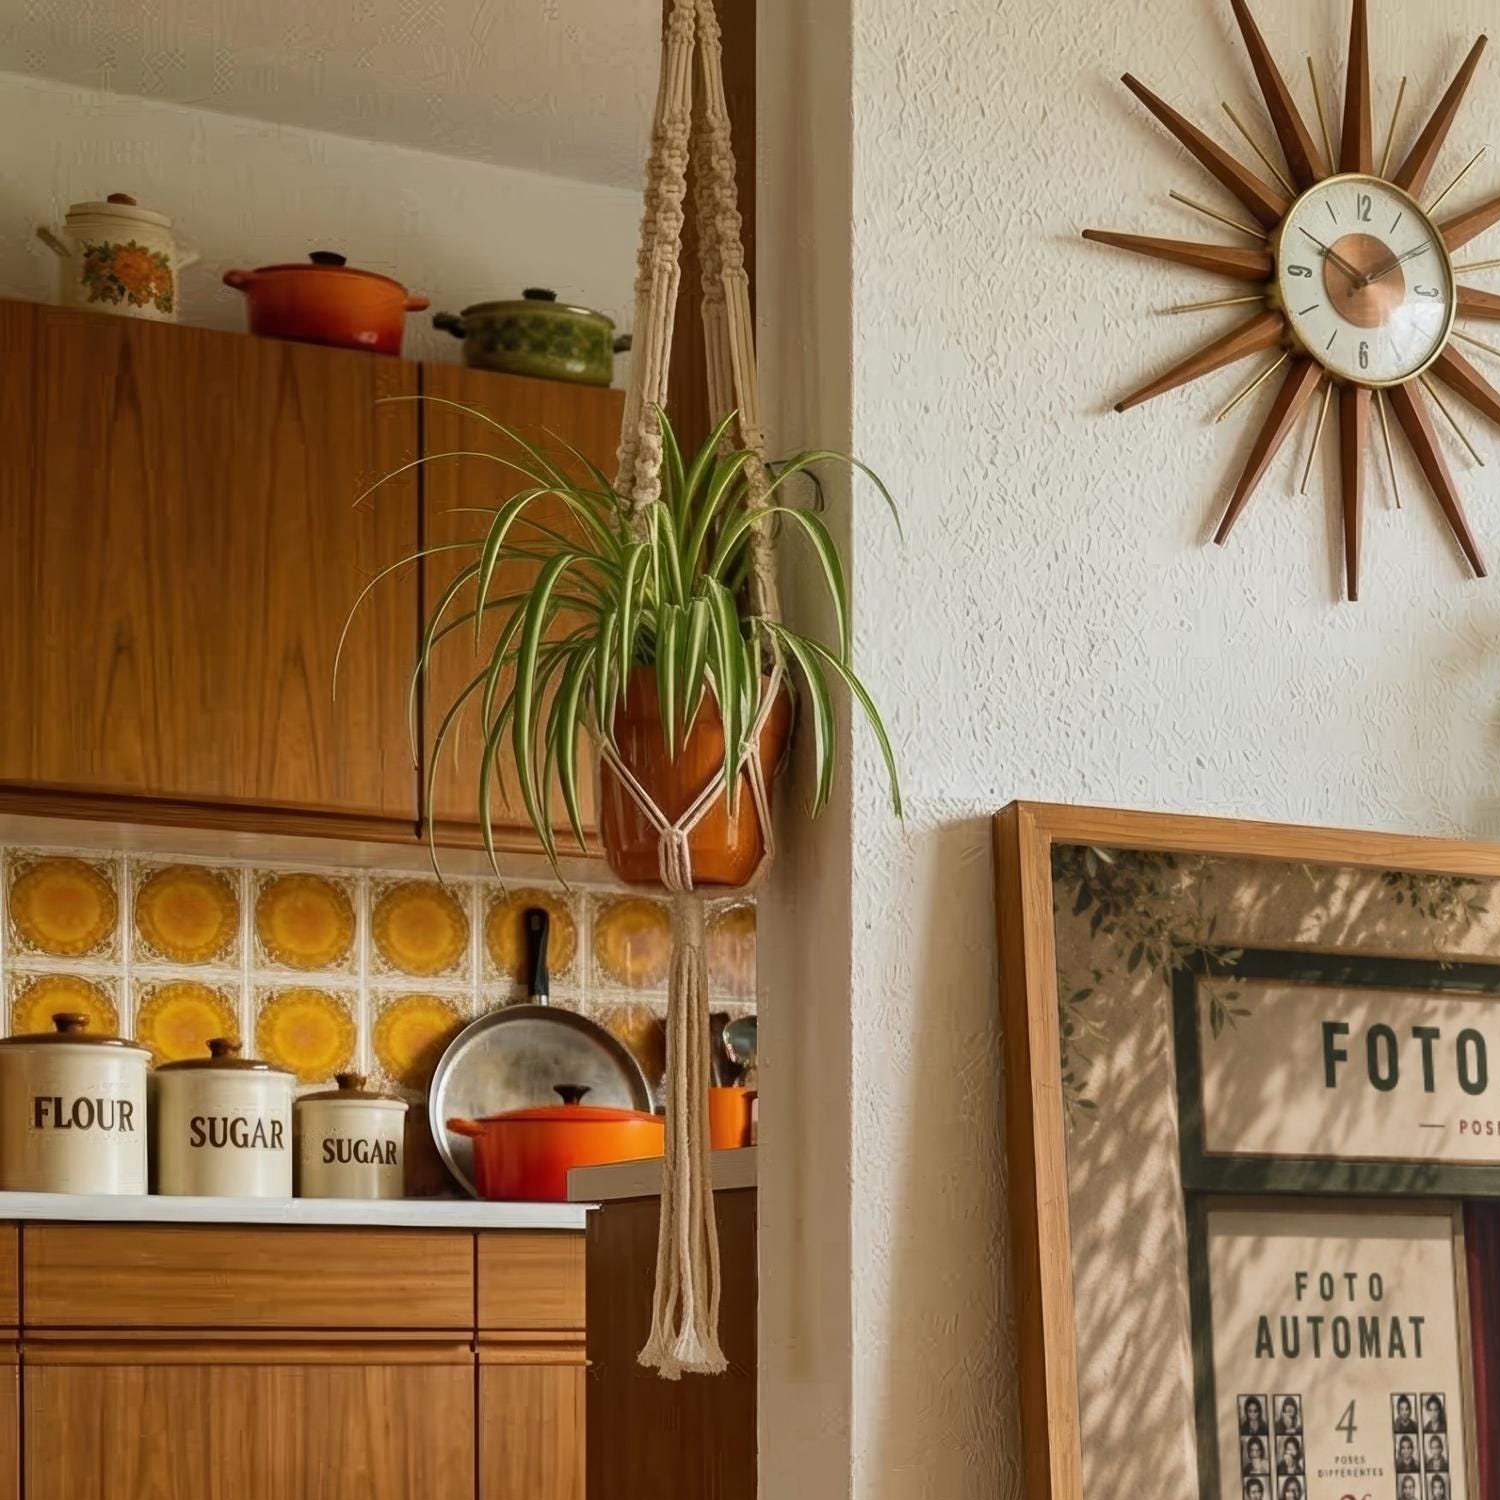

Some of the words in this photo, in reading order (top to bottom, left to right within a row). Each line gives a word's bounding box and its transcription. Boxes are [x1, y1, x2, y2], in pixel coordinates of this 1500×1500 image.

[1357, 192, 1372, 222] 12
[34, 1096, 134, 1132] FLOUR
[189, 1115, 284, 1150] SUGAR
[322, 1138, 397, 1165] SUGAR
[1295, 1271, 1384, 1302] FOTO
[1255, 1315, 1425, 1358] AUTOMAT
[1335, 1399, 1357, 1444] 4
[1334, 1455, 1366, 1465] POSES
